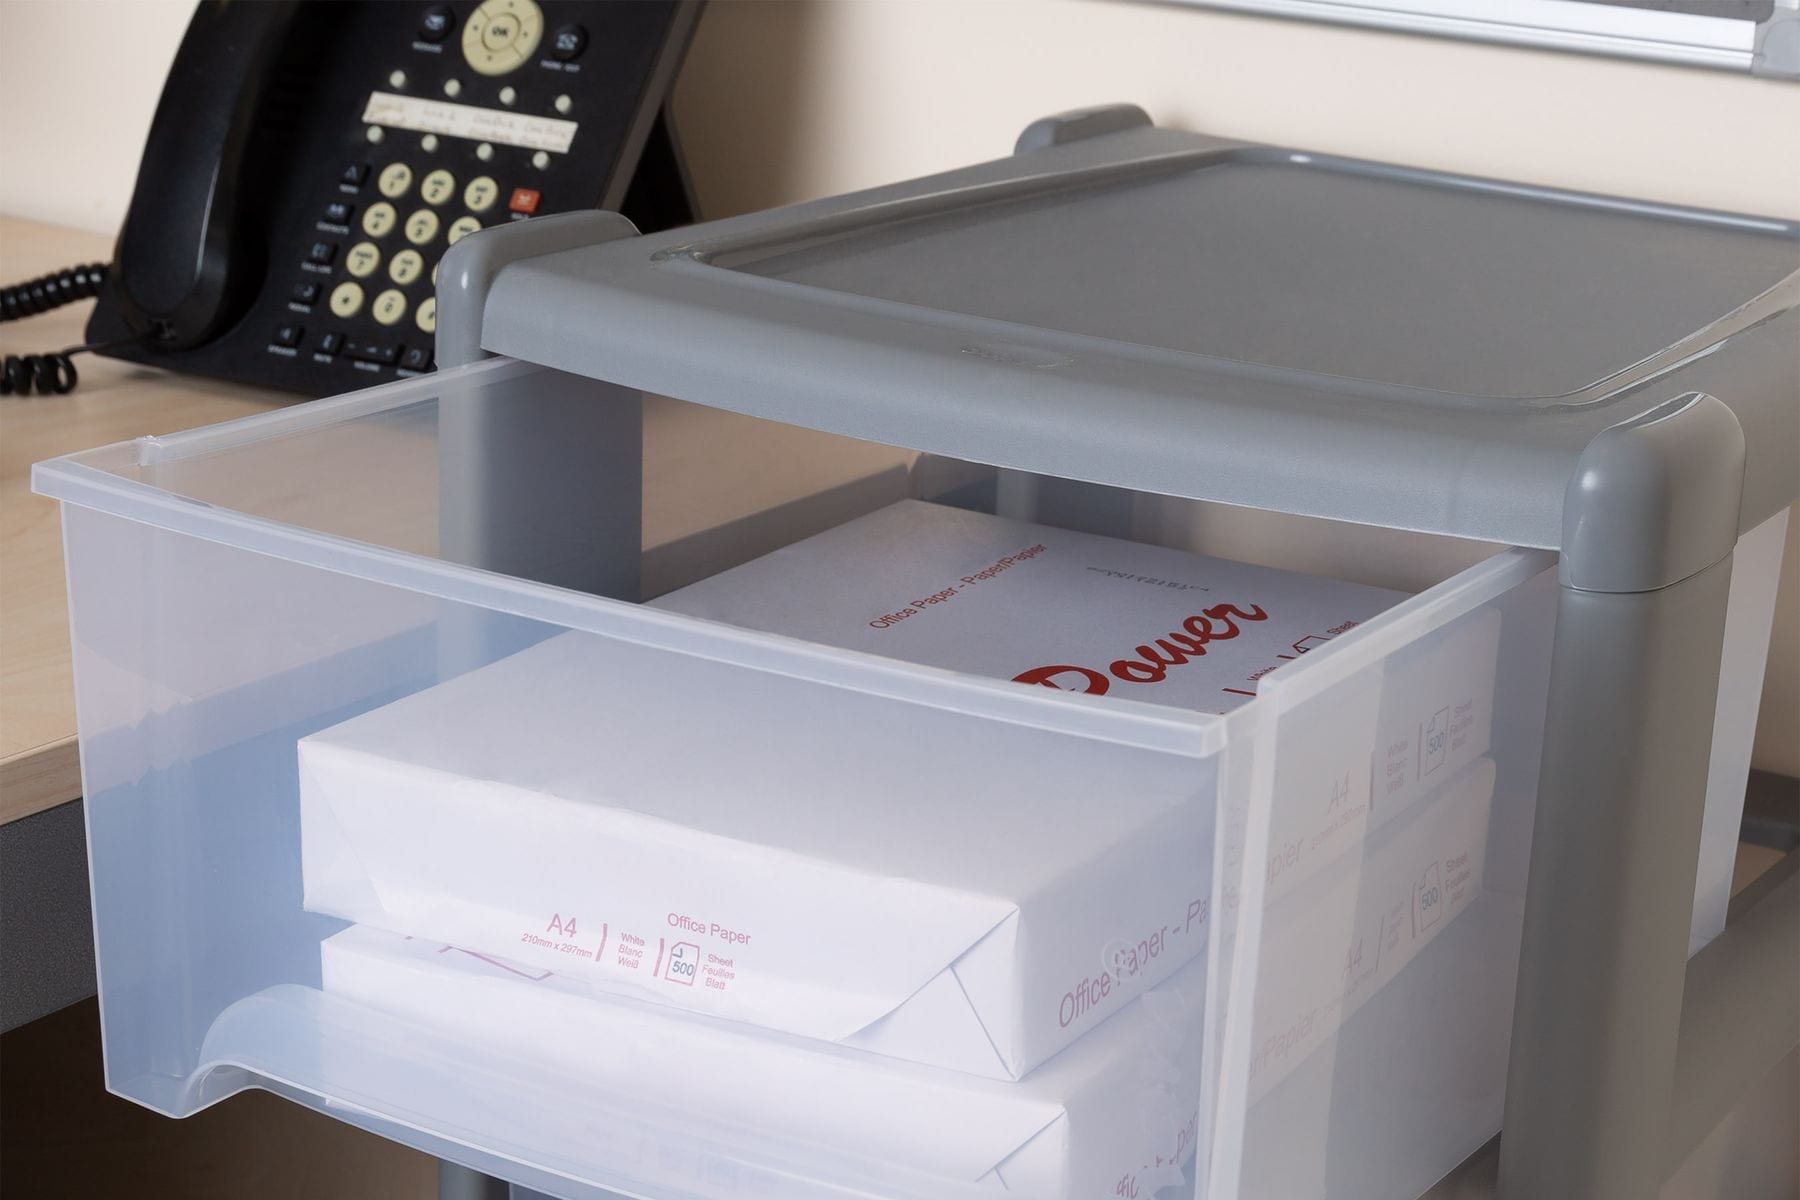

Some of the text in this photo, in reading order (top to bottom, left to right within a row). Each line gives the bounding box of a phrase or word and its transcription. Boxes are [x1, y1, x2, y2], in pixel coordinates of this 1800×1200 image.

[869, 607, 917, 629] Office
[910, 586, 958, 610] Paper
[960, 543, 1048, 585] Paper/Papier
[1328, 769, 1350, 814] A4
[1421, 886, 1438, 911] 500
[546, 913, 578, 938] A4
[667, 912, 751, 946] Office Paper
[521, 932, 553, 951] 210mm
[560, 942, 593, 960] 297mm
[621, 931, 646, 947] White
[618, 943, 644, 959] Blanc
[707, 953, 735, 969] Sheet
[617, 956, 639, 970] Weiß
[672, 960, 695, 977] 500
[702, 964, 736, 981] Feuilles
[705, 977, 726, 991] Blatt
[1058, 971, 1112, 1029] Office
